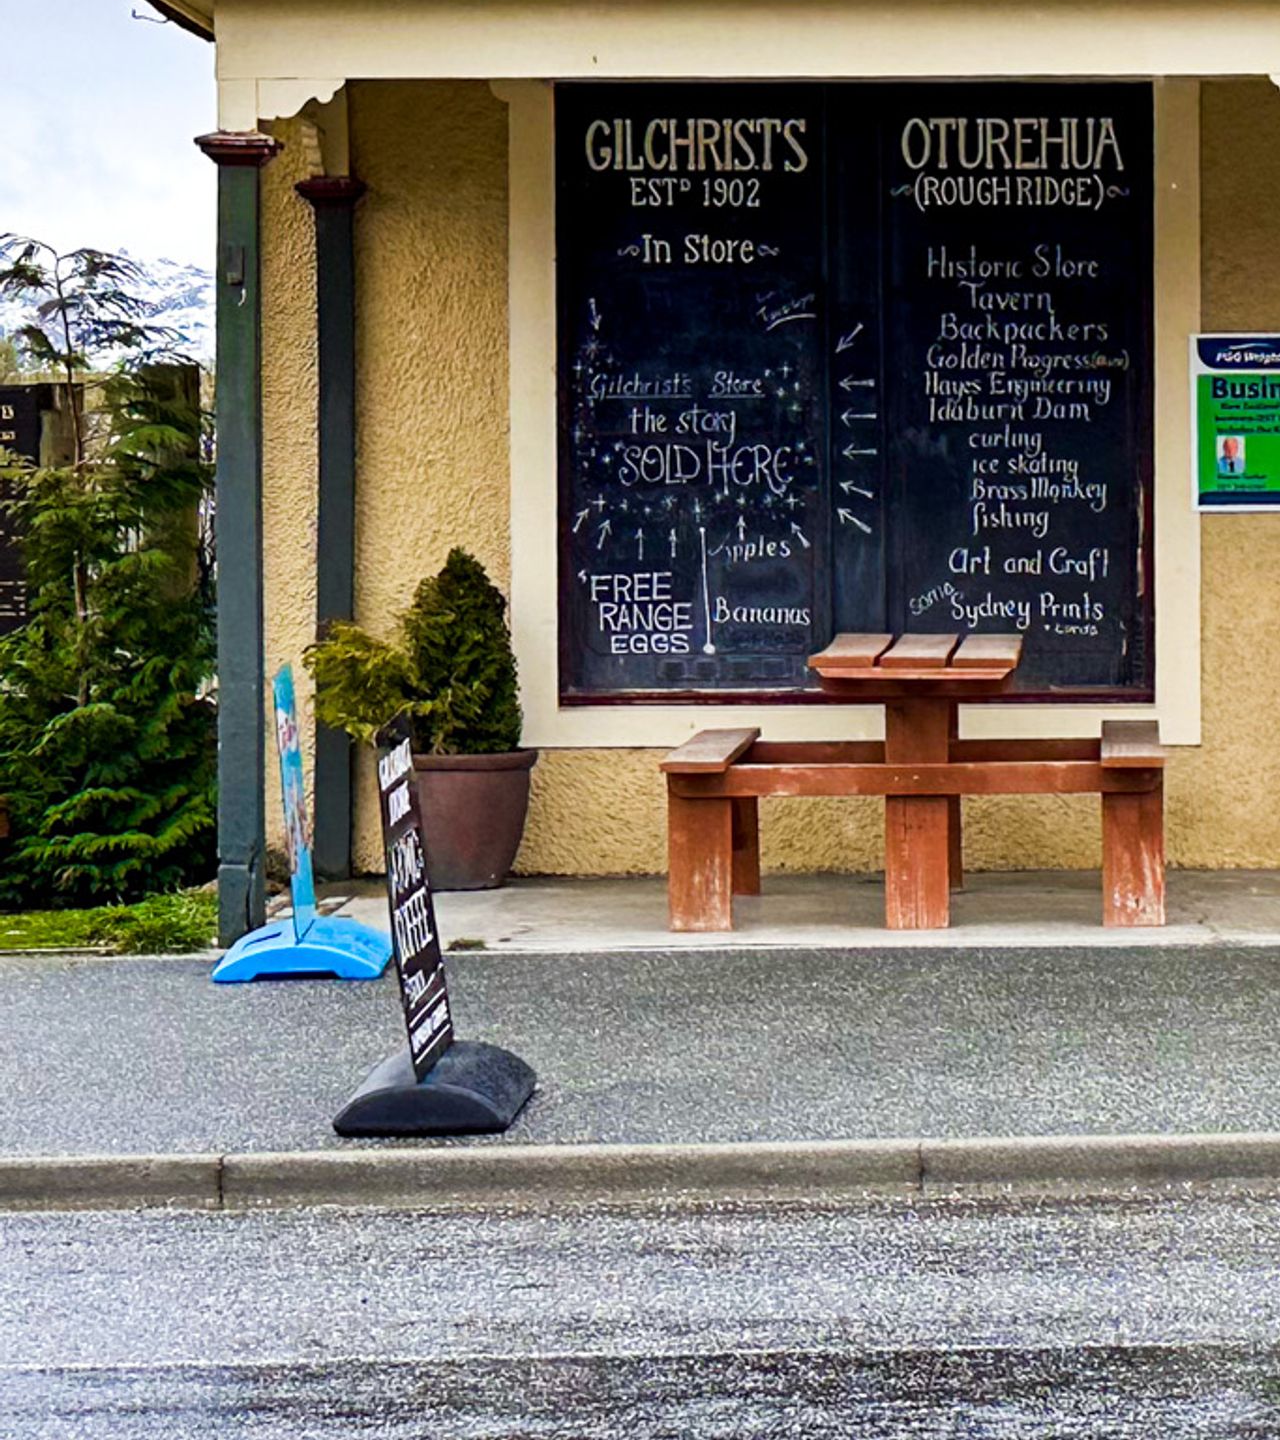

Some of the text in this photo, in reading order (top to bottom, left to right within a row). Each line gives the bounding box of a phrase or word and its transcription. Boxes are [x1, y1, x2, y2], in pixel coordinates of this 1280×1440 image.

[901, 117, 1124, 171] OTUREHUA
[702, 177, 760, 208] 1902
[641, 233, 755, 264] In Store
[927, 243, 1100, 279] Historic Store
[958, 280, 1054, 313] Tavern
[938, 312, 1109, 345] Backpackers
[926, 341, 1005, 370] Golden
[1010, 343, 1092, 379] Progress
[711, 370, 764, 396] Store
[989, 370, 1112, 406] Engineering
[629, 402, 737, 450] the story
[928, 396, 1091, 423] Idaburn Dam
[968, 424, 1043, 458] curling
[618, 438, 794, 497] SOLD HERE
[972, 451, 1079, 483] ice skating
[971, 476, 1108, 513] Brass Monkey
[972, 501, 1050, 539] fishing
[948, 545, 1109, 582] Art and Craft
[589, 571, 673, 603] FREE
[599, 602, 694, 632] RANGE
[713, 595, 812, 626] Bananas
[949, 591, 1105, 630] Sydney Prints
[610, 634, 690, 655] EGGS
